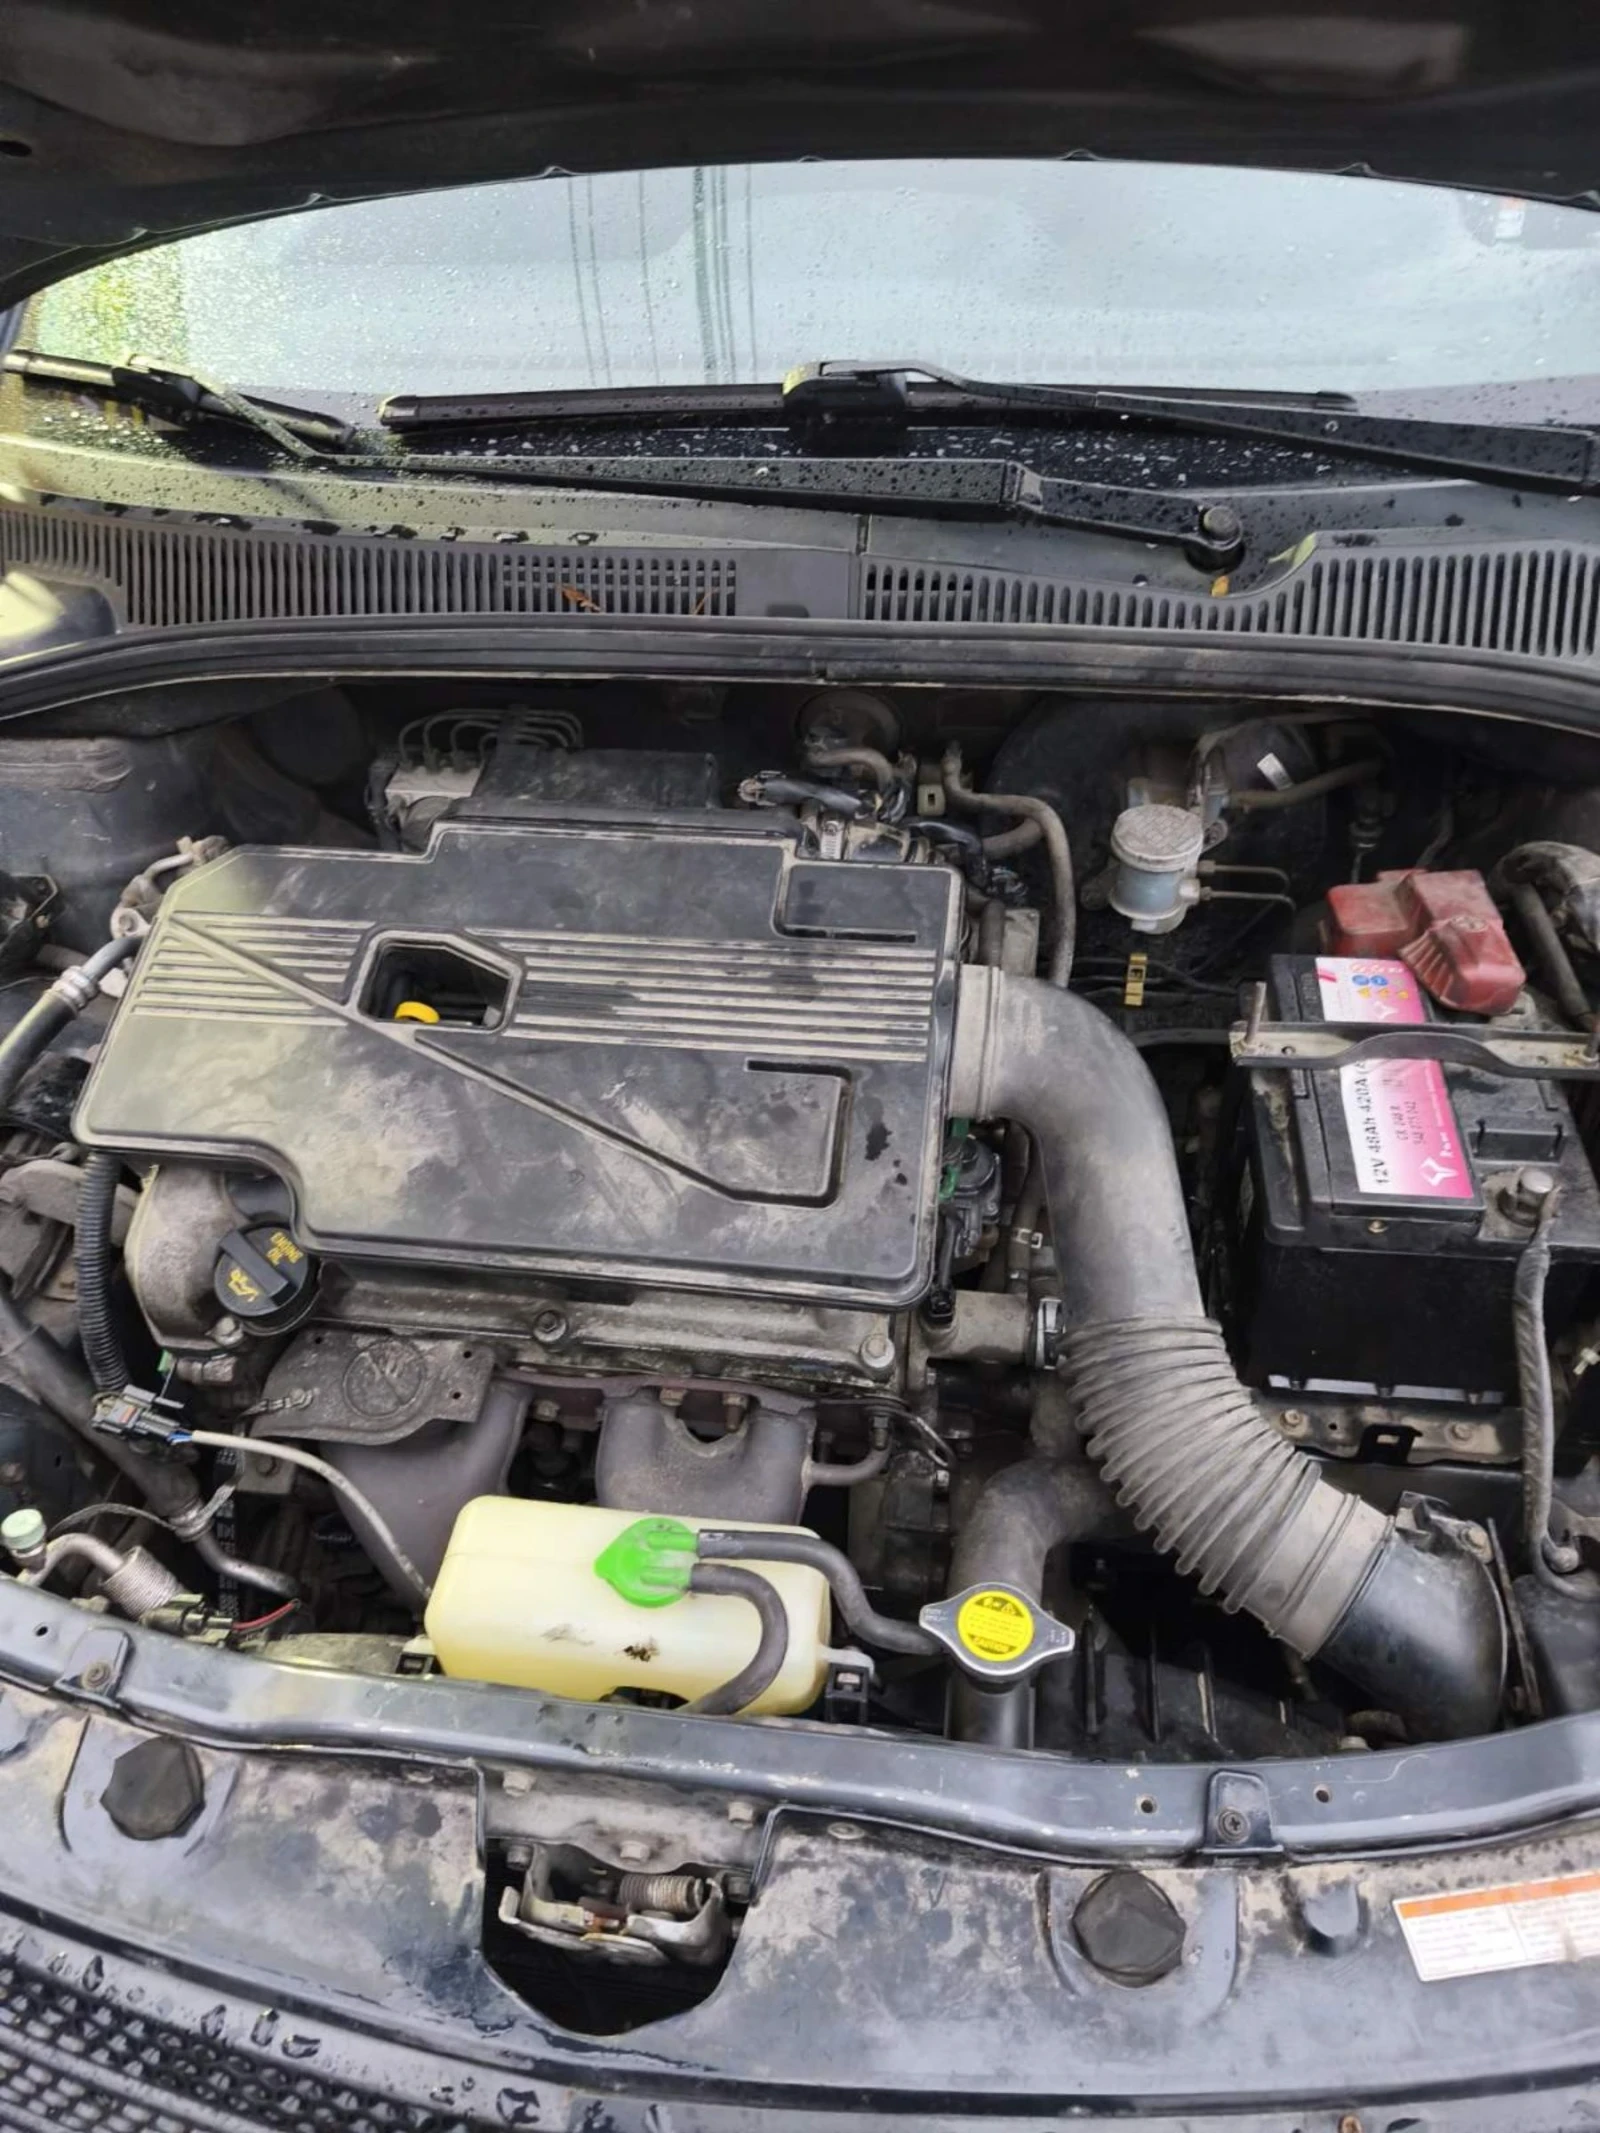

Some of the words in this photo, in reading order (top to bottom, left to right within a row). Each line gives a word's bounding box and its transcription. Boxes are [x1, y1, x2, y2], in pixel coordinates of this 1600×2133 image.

[1354, 1078, 1372, 1112] 420A
[1361, 1117, 1383, 1153] 48Ah
[1370, 1157, 1390, 1184] 12V
[266, 1246, 284, 1266] OIL
[270, 1232, 304, 1264] ENGINE
